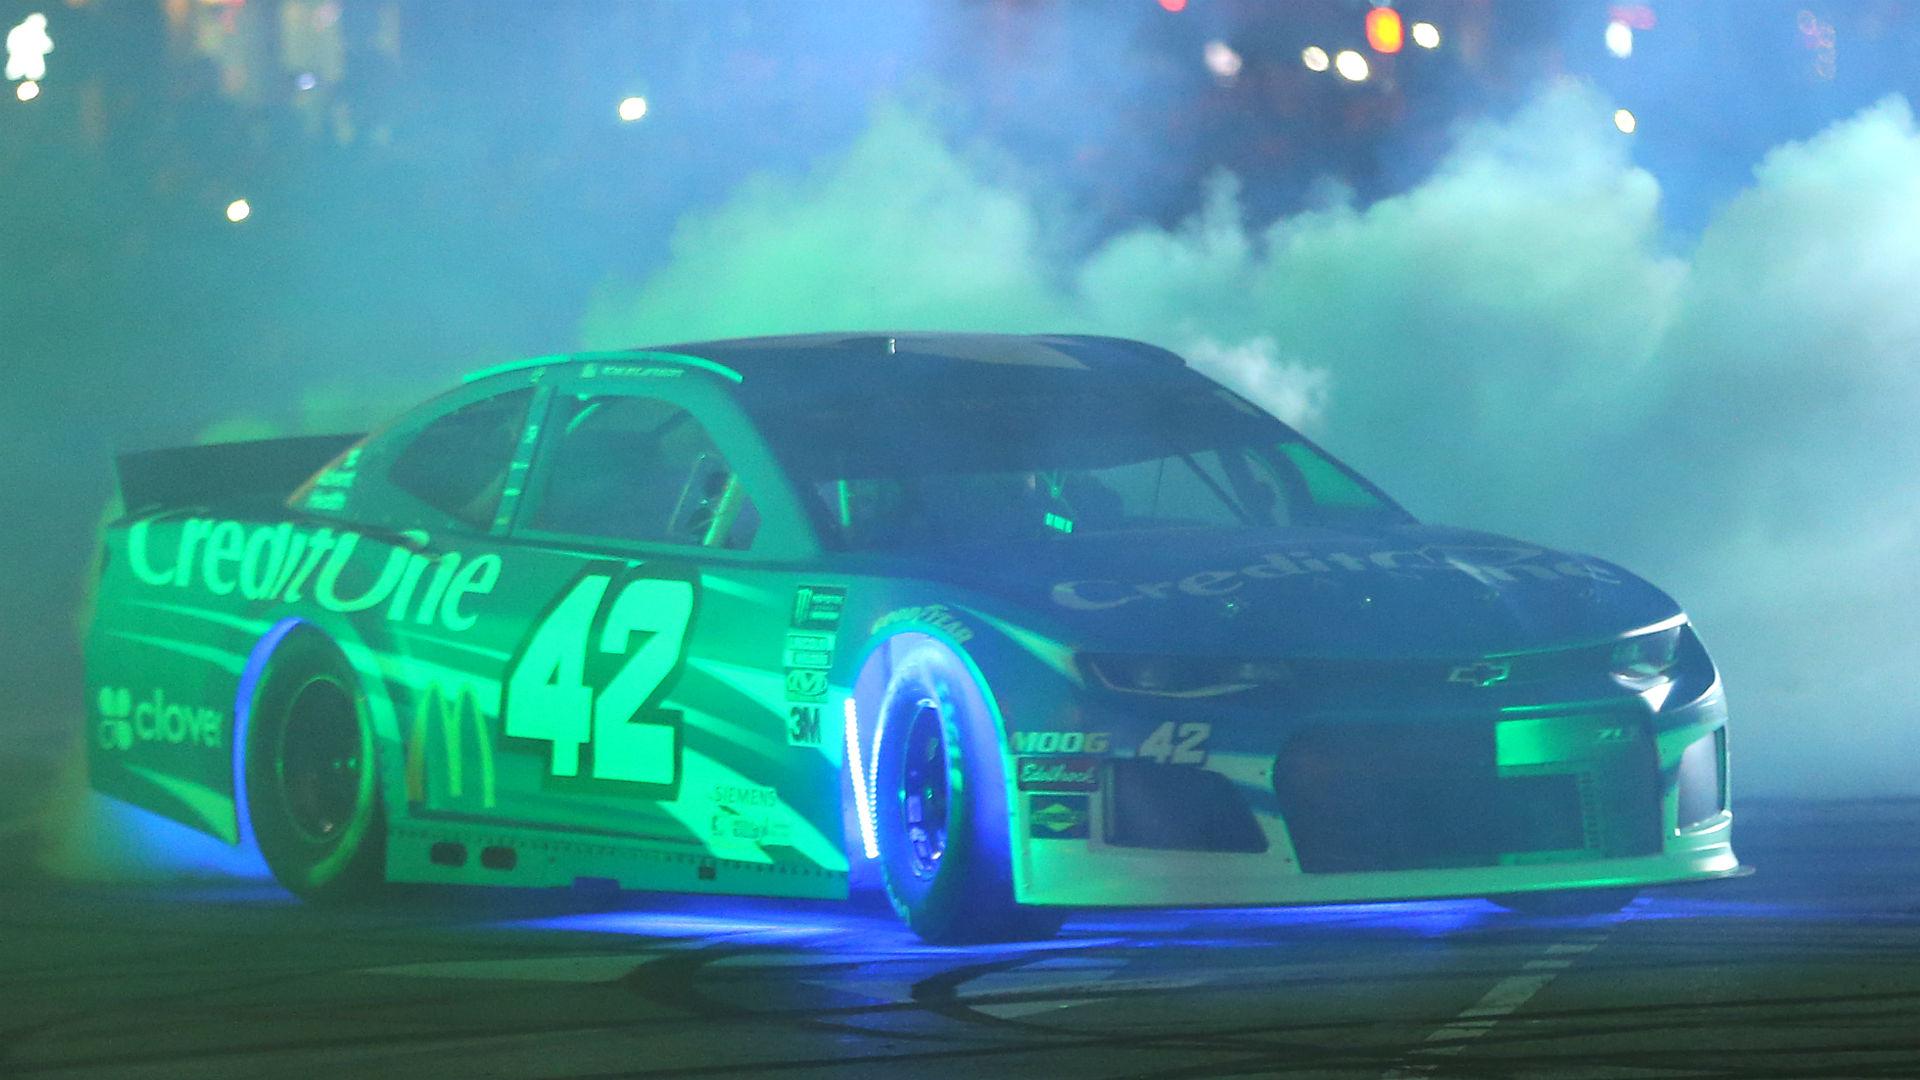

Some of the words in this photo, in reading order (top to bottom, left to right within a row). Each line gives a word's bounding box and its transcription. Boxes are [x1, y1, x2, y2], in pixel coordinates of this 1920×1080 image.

[505, 574, 694, 785] 42
[790, 706, 821, 744] 3M
[1013, 731, 1111, 753] MOOG
[1138, 721, 1212, 765] 42
[713, 784, 777, 807] SIEMENS
